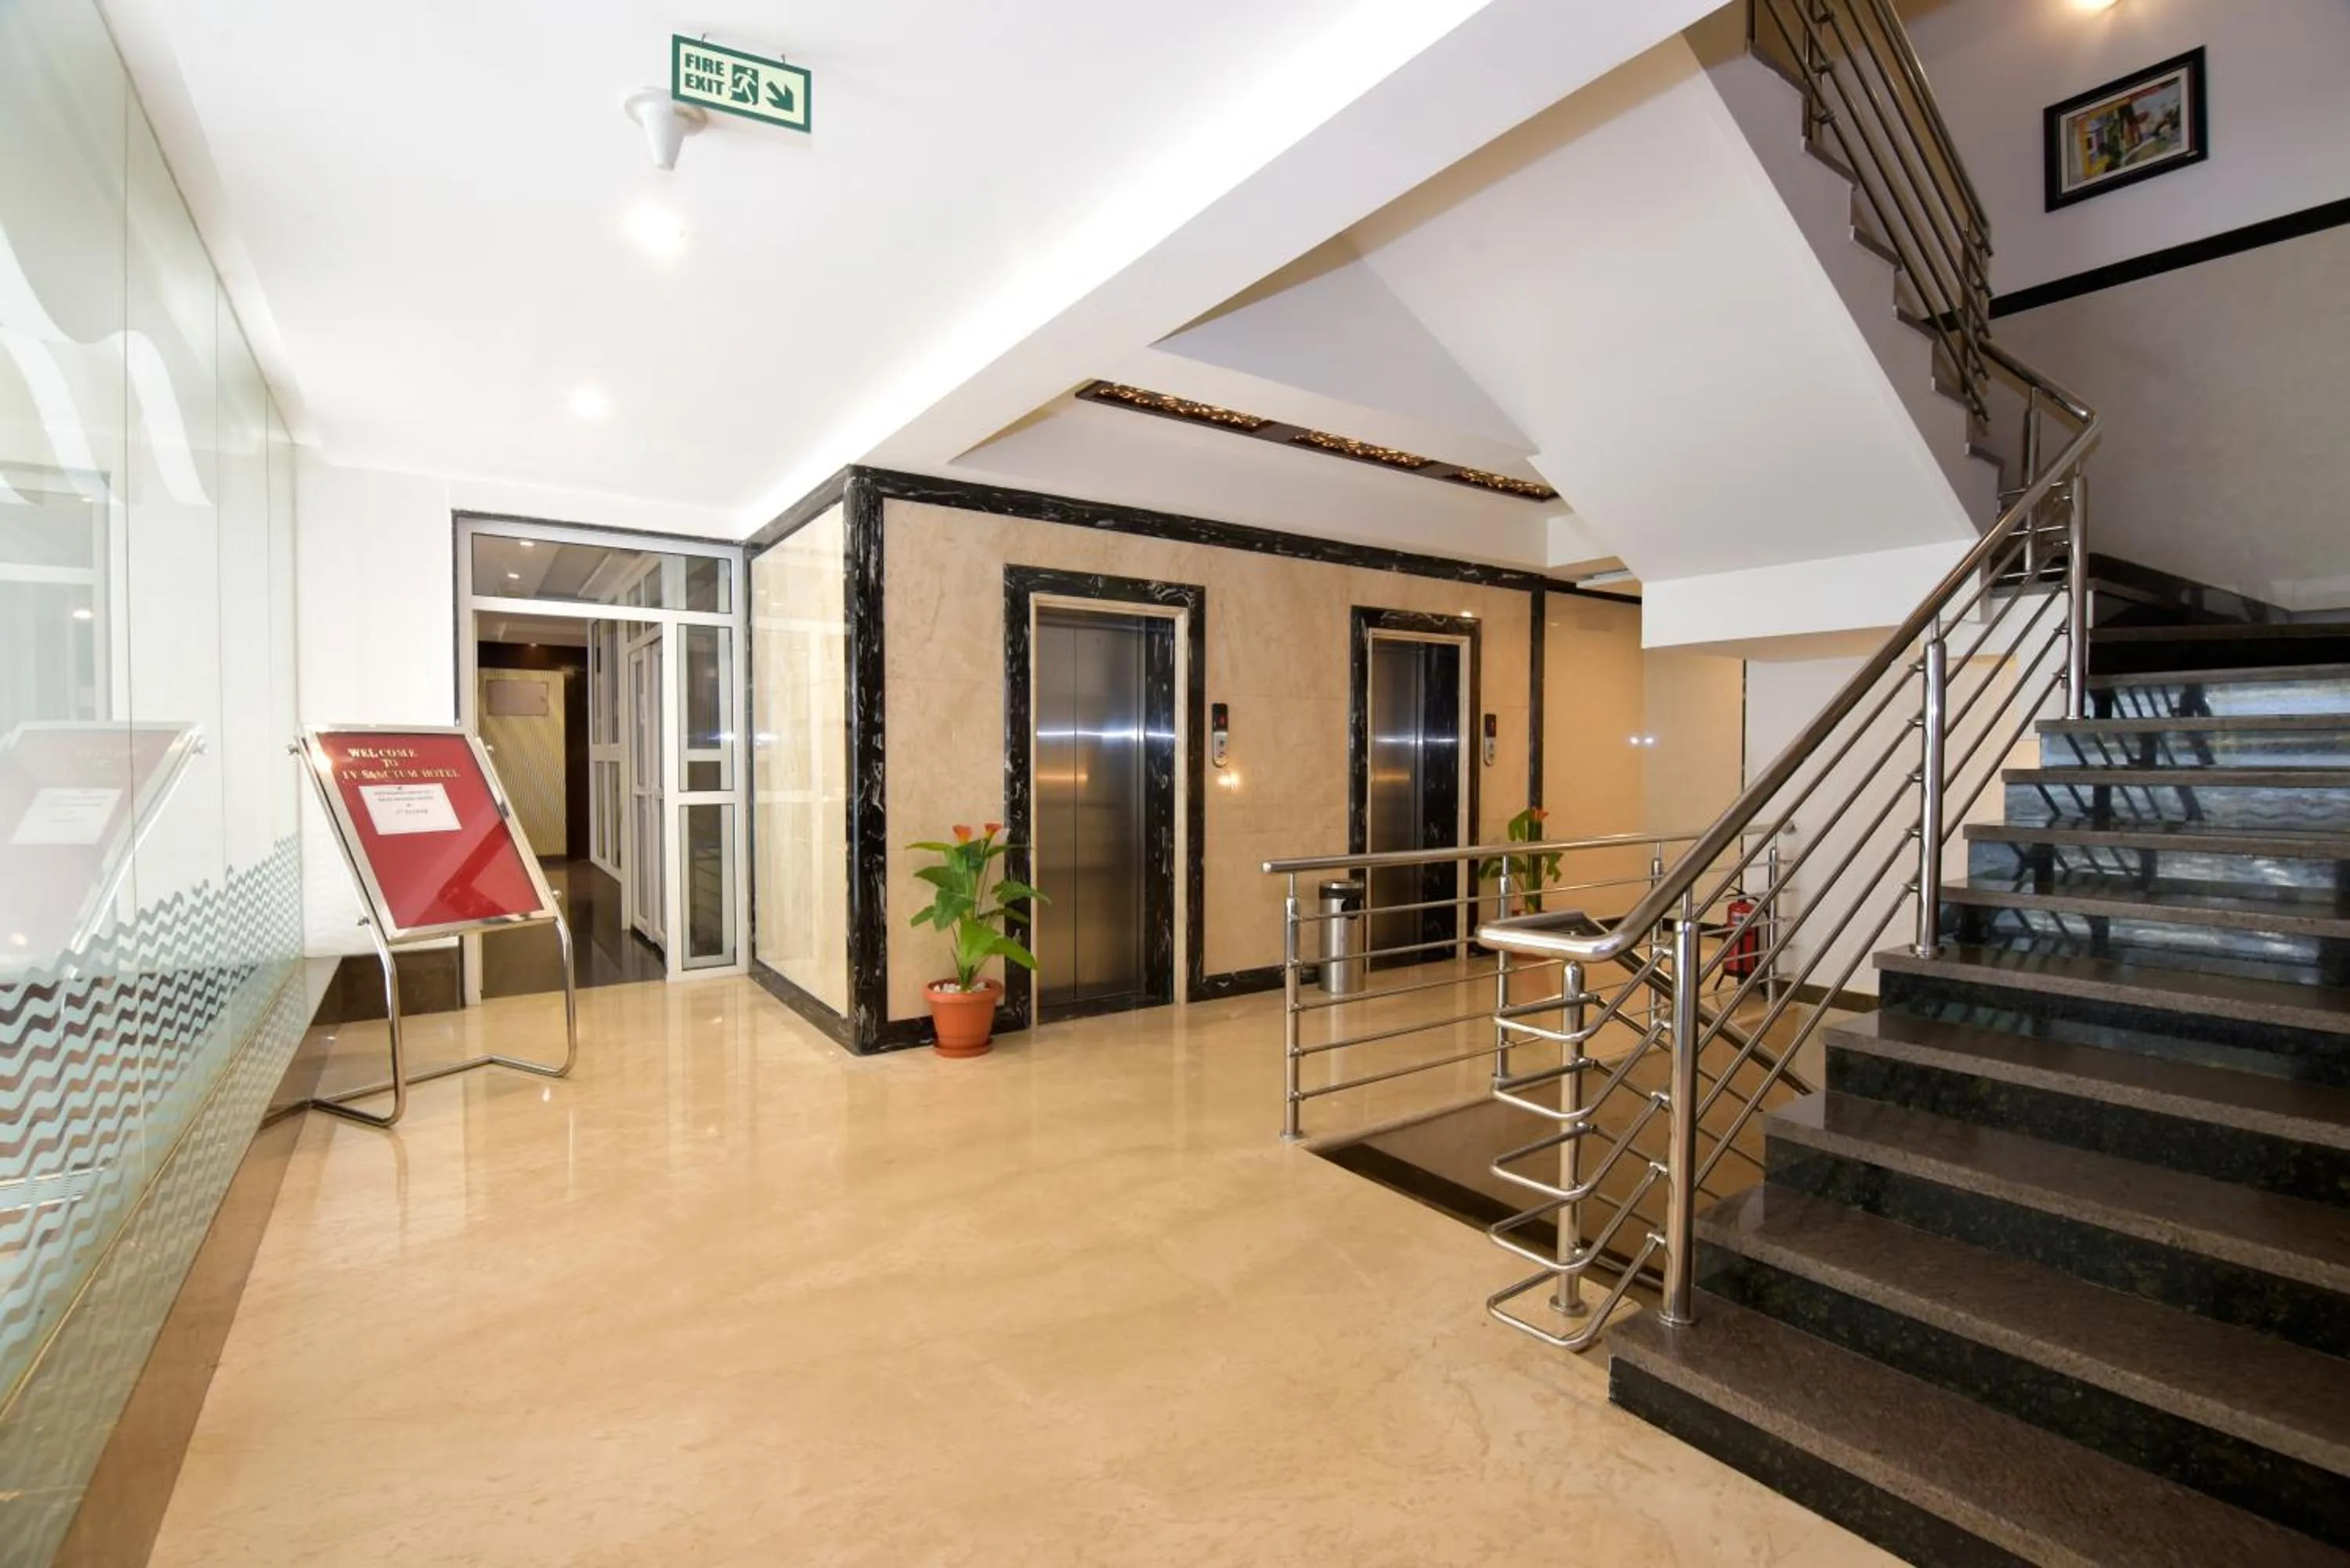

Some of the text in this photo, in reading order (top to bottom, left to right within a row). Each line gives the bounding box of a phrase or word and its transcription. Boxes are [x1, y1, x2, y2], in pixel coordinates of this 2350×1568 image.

[685, 52, 725, 76] FIRE
[685, 73, 725, 96] EXIT
[348, 748, 418, 757] WELCOME
[381, 758, 399, 768] TO
[361, 769, 418, 779] SANCTUM
[421, 768, 461, 778] HOTEL
